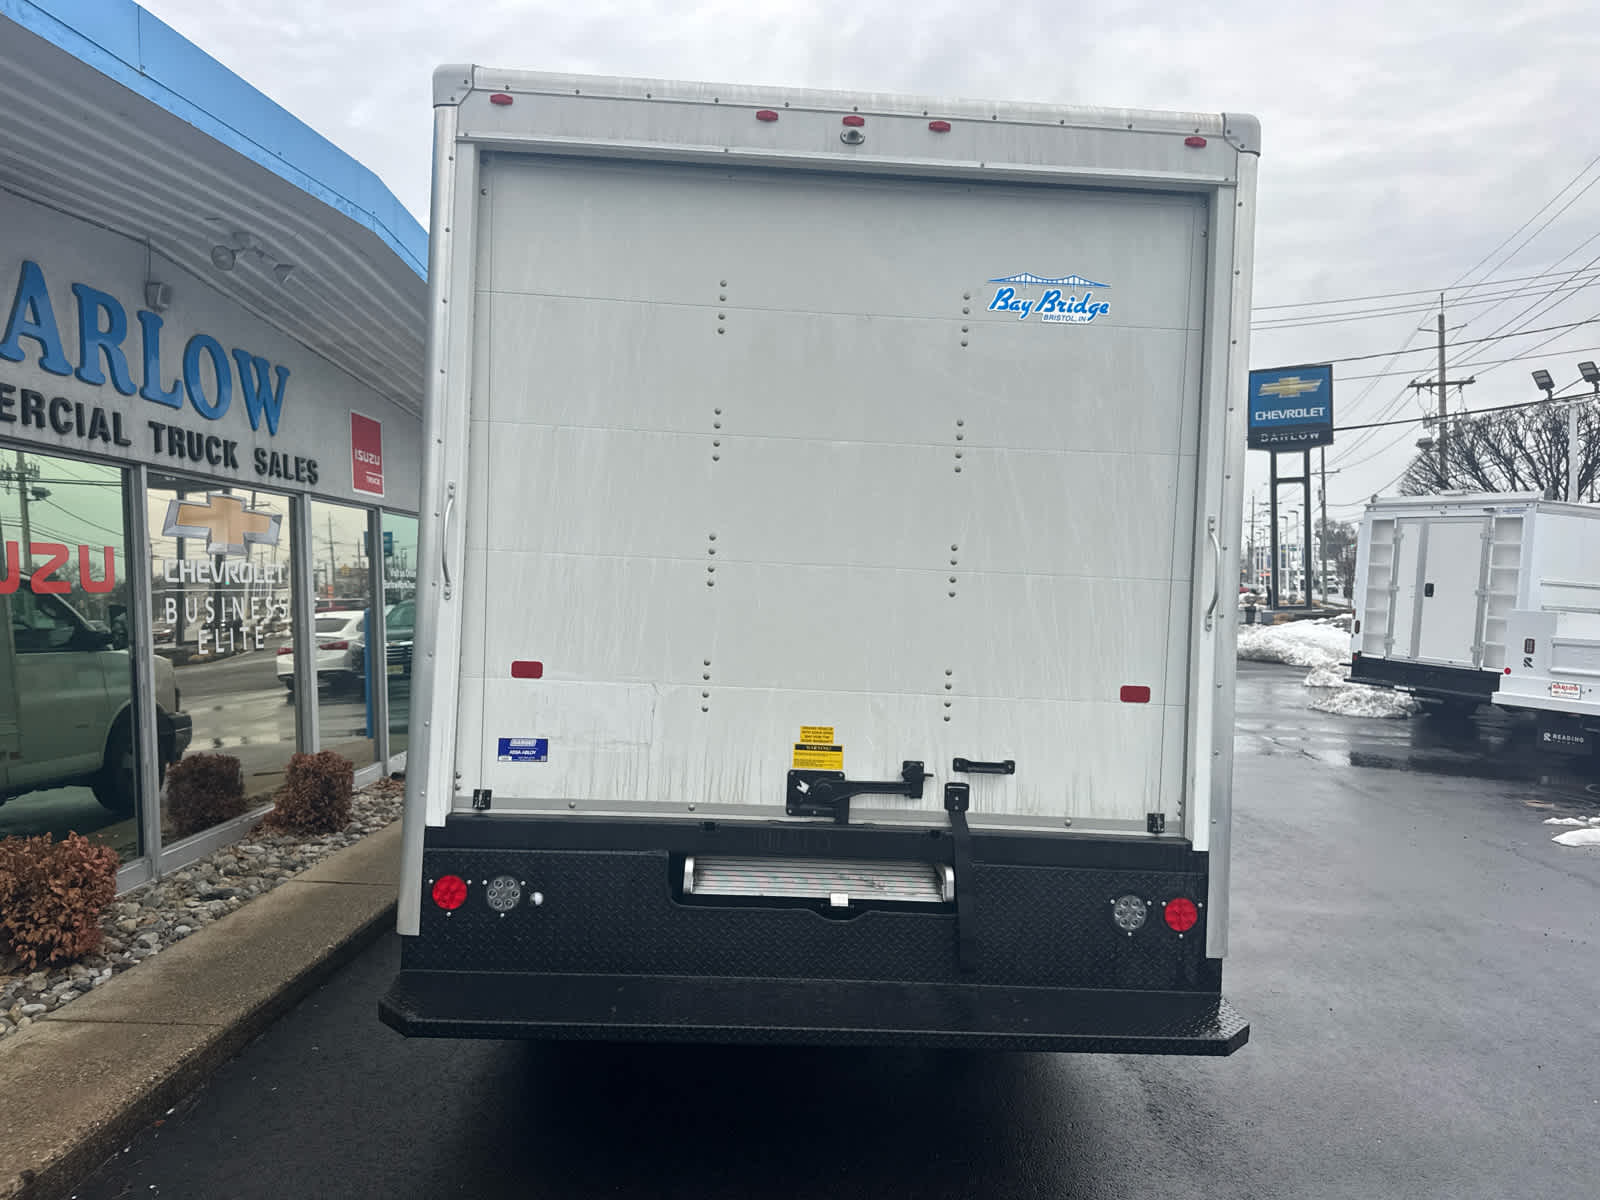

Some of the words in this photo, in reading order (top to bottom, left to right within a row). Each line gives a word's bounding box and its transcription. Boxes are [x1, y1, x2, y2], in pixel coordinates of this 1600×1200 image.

[989, 286, 1033, 319] Bay
[1035, 289, 1110, 321] Bridge
[1255, 407, 1326, 421] CHEVROLET
[148, 420, 239, 469] TRUCK
[254, 447, 318, 485] SALES
[355, 448, 380, 466] ISUZU
[164, 558, 285, 584] CHEVROLET
[165, 596, 289, 624] BUSINESS
[199, 626, 265, 654] ELITE
